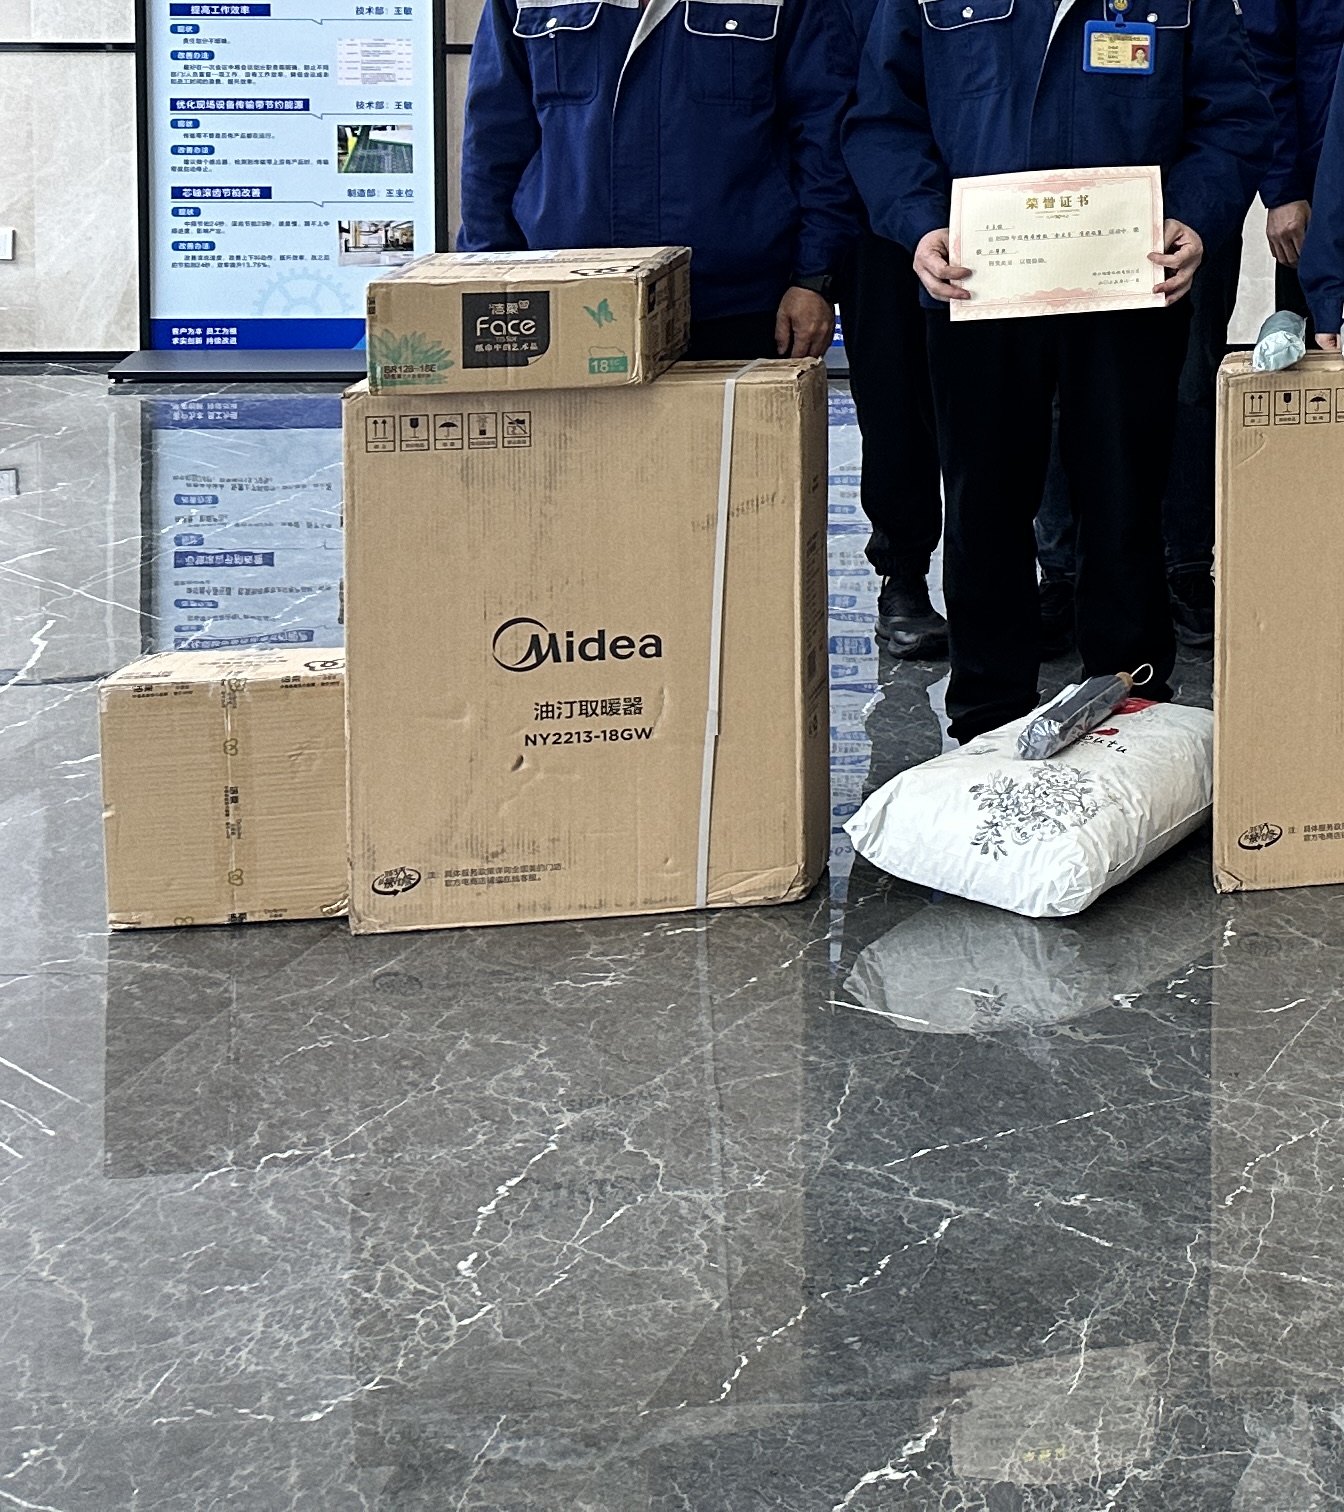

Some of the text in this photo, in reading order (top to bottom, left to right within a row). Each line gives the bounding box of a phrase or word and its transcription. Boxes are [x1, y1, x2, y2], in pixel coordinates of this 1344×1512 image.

[190, 5, 251, 15] 提高工作效率
[1025, 194, 1090, 210] 荣誉证书
[476, 316, 537, 336] Face
[492, 616, 663, 672] Midea
[533, 696, 644, 721] 油汀取暖器
[524, 726, 655, 747] NY2213-18GW
